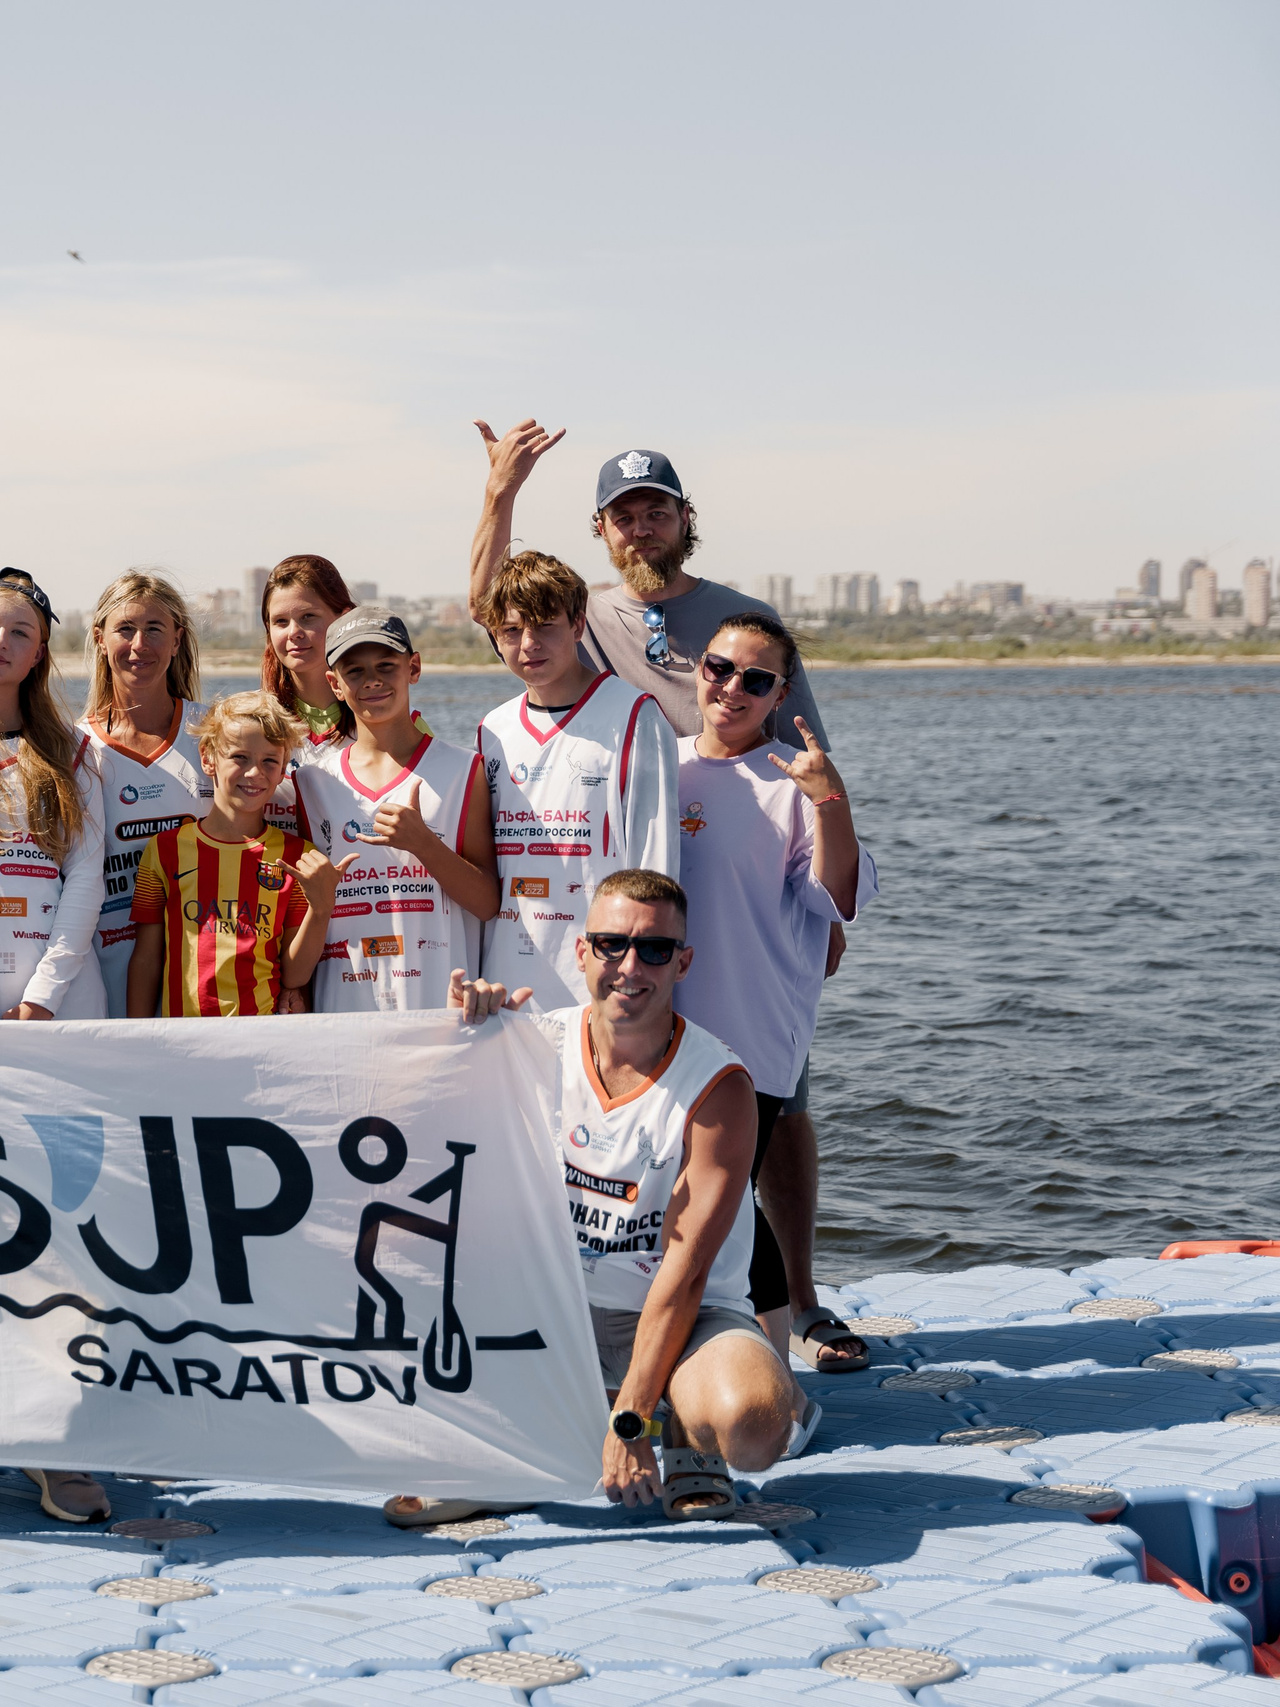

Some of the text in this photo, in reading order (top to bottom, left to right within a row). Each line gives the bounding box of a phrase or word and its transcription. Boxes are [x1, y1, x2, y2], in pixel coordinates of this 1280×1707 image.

[496, 809, 591, 823] ЛЬФА-БАНК
[121, 819, 180, 837] WINLINE
[545, 828, 591, 838] РОССИИ
[106, 875, 128, 896] ПО
[392, 883, 434, 894] РОССИИ
[183, 898, 272, 926] QATAR
[497, 908, 520, 922] mily
[203, 920, 272, 939] AIRWAYS
[342, 968, 378, 982] Family
[565, 1166, 624, 1196] WINLINE
[568, 1200, 666, 1236] НАТ РОСС
[66, 1333, 418, 1407] SARATOV
